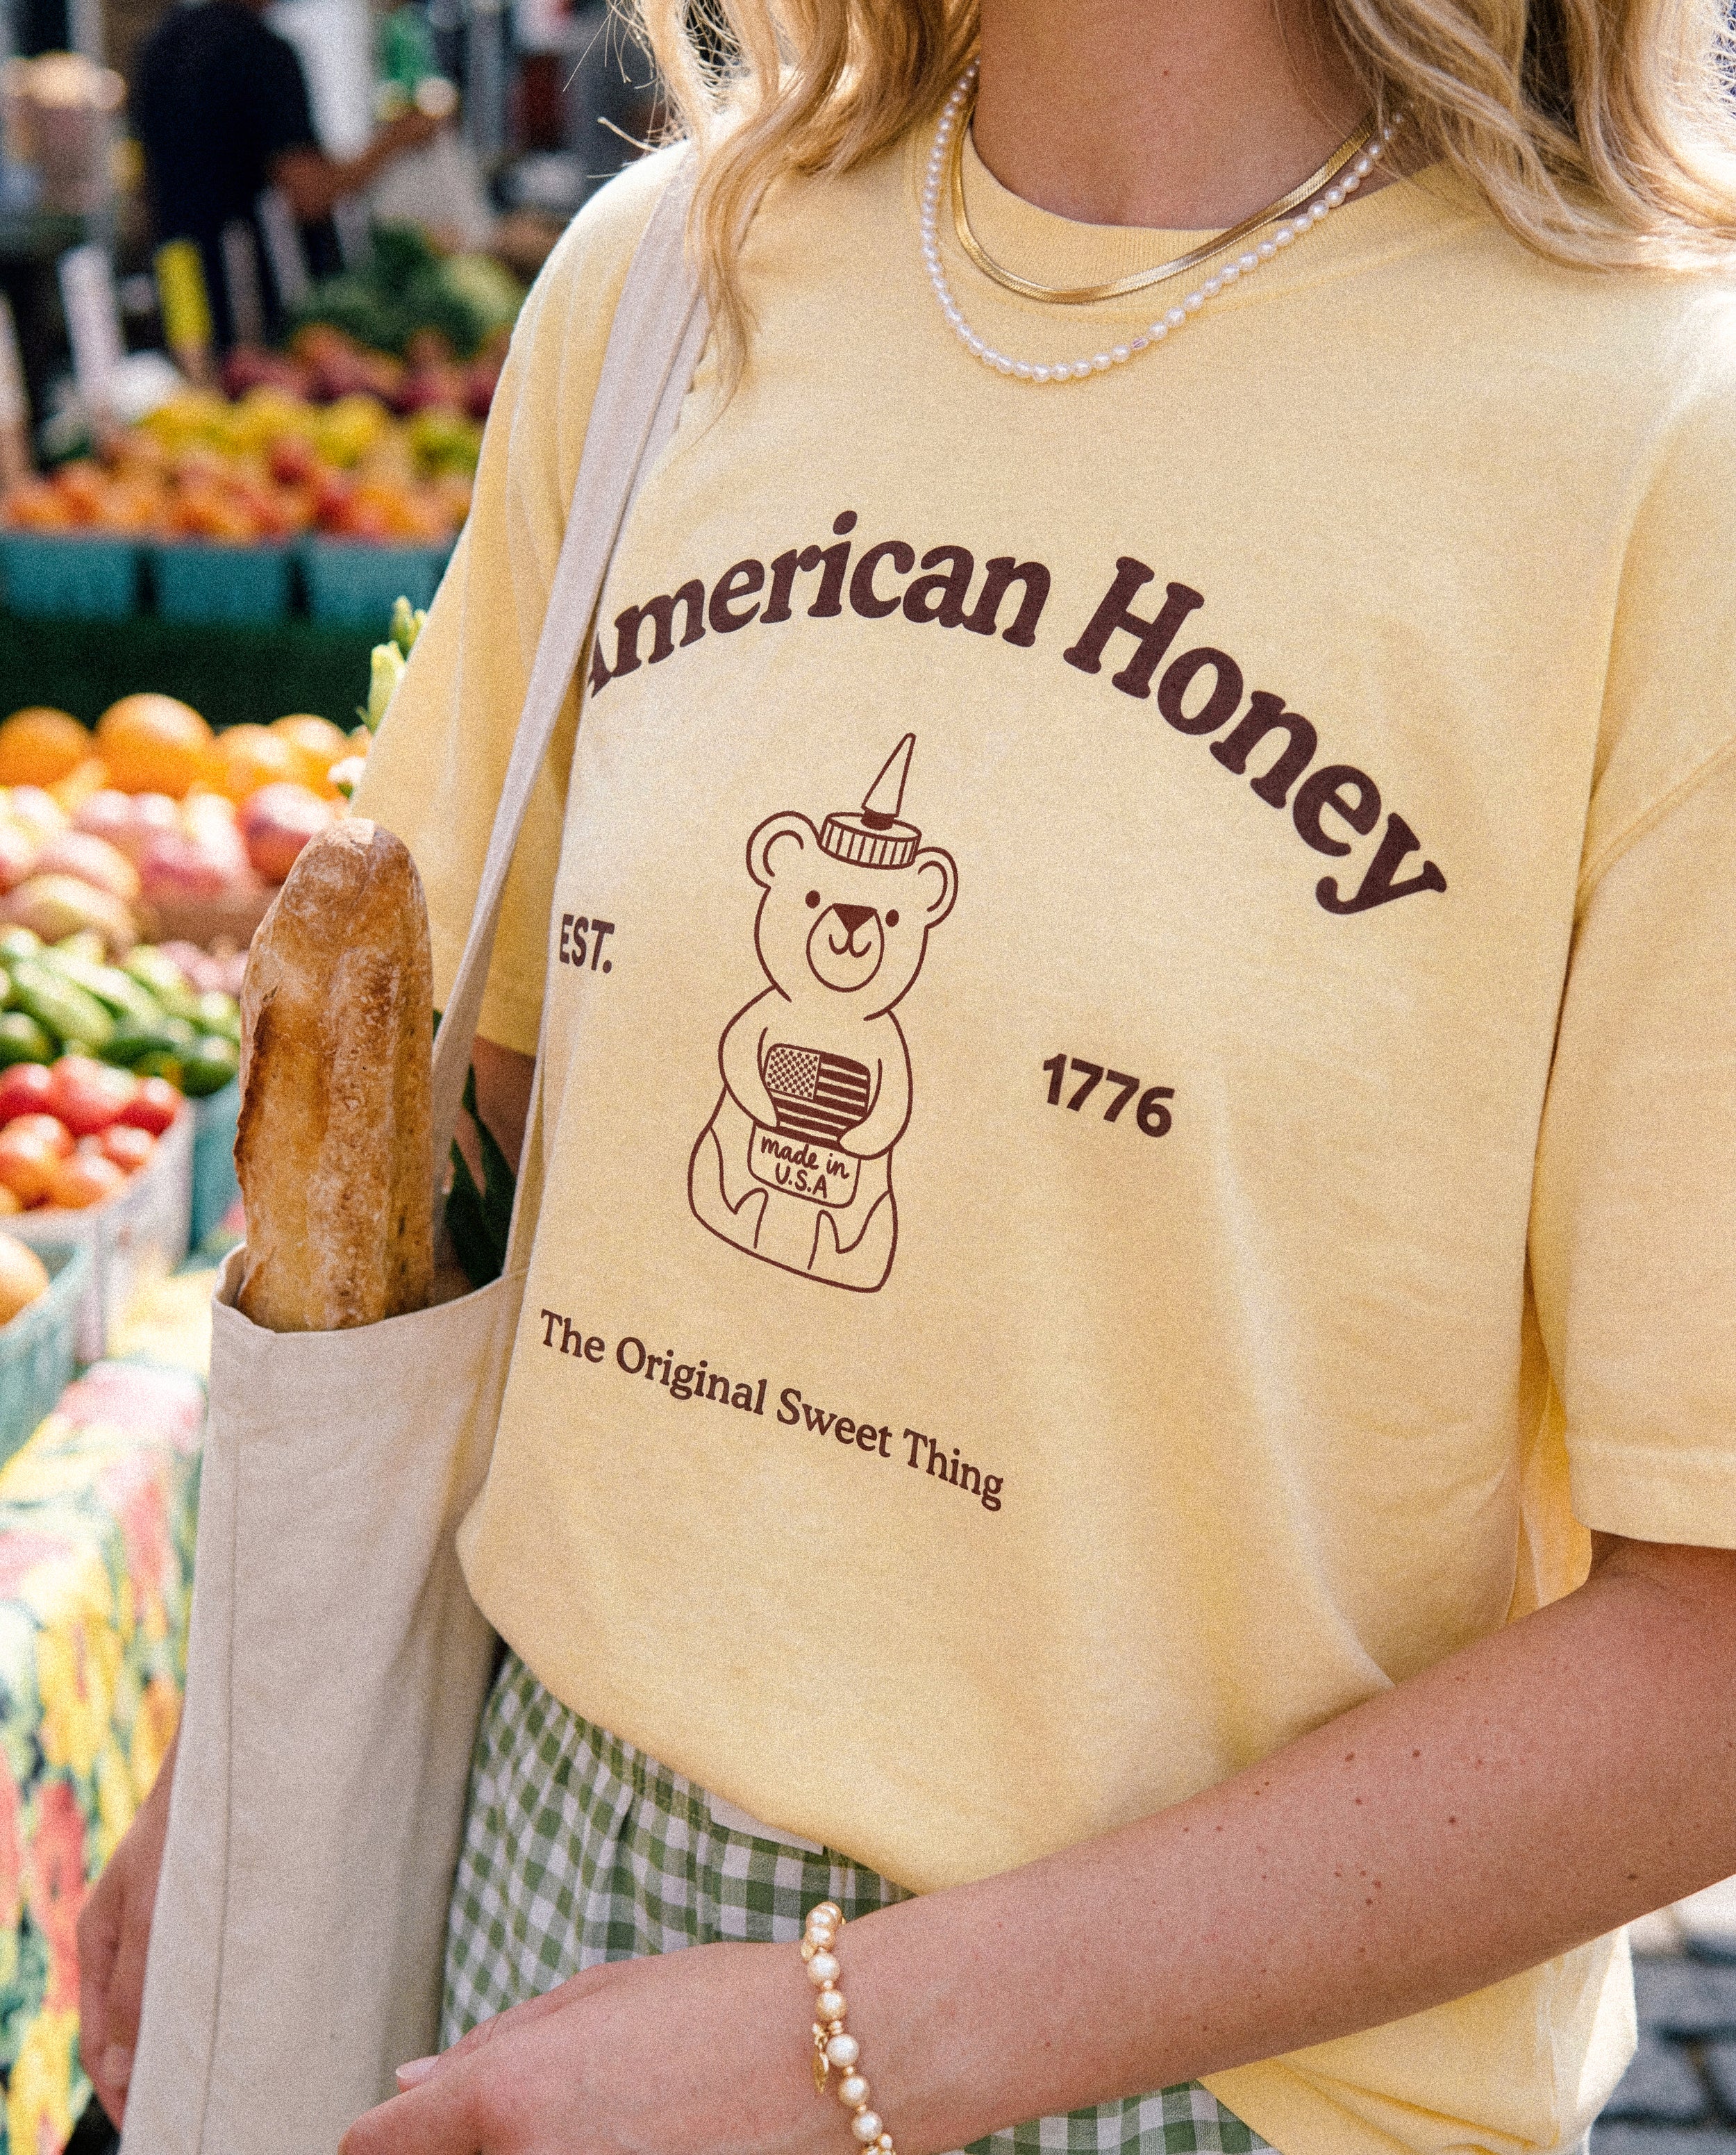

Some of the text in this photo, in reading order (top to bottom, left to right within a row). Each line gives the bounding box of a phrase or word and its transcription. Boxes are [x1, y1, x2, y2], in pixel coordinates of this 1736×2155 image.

[1062, 556, 1447, 915] Honey
[558, 913, 615, 974] EST.
[1042, 1053, 1176, 1138] 1776
[761, 1136, 850, 1180] made in
[775, 1162, 828, 1199] U.S.A
[540, 1308, 1004, 1512] The Original Sweet Thing
